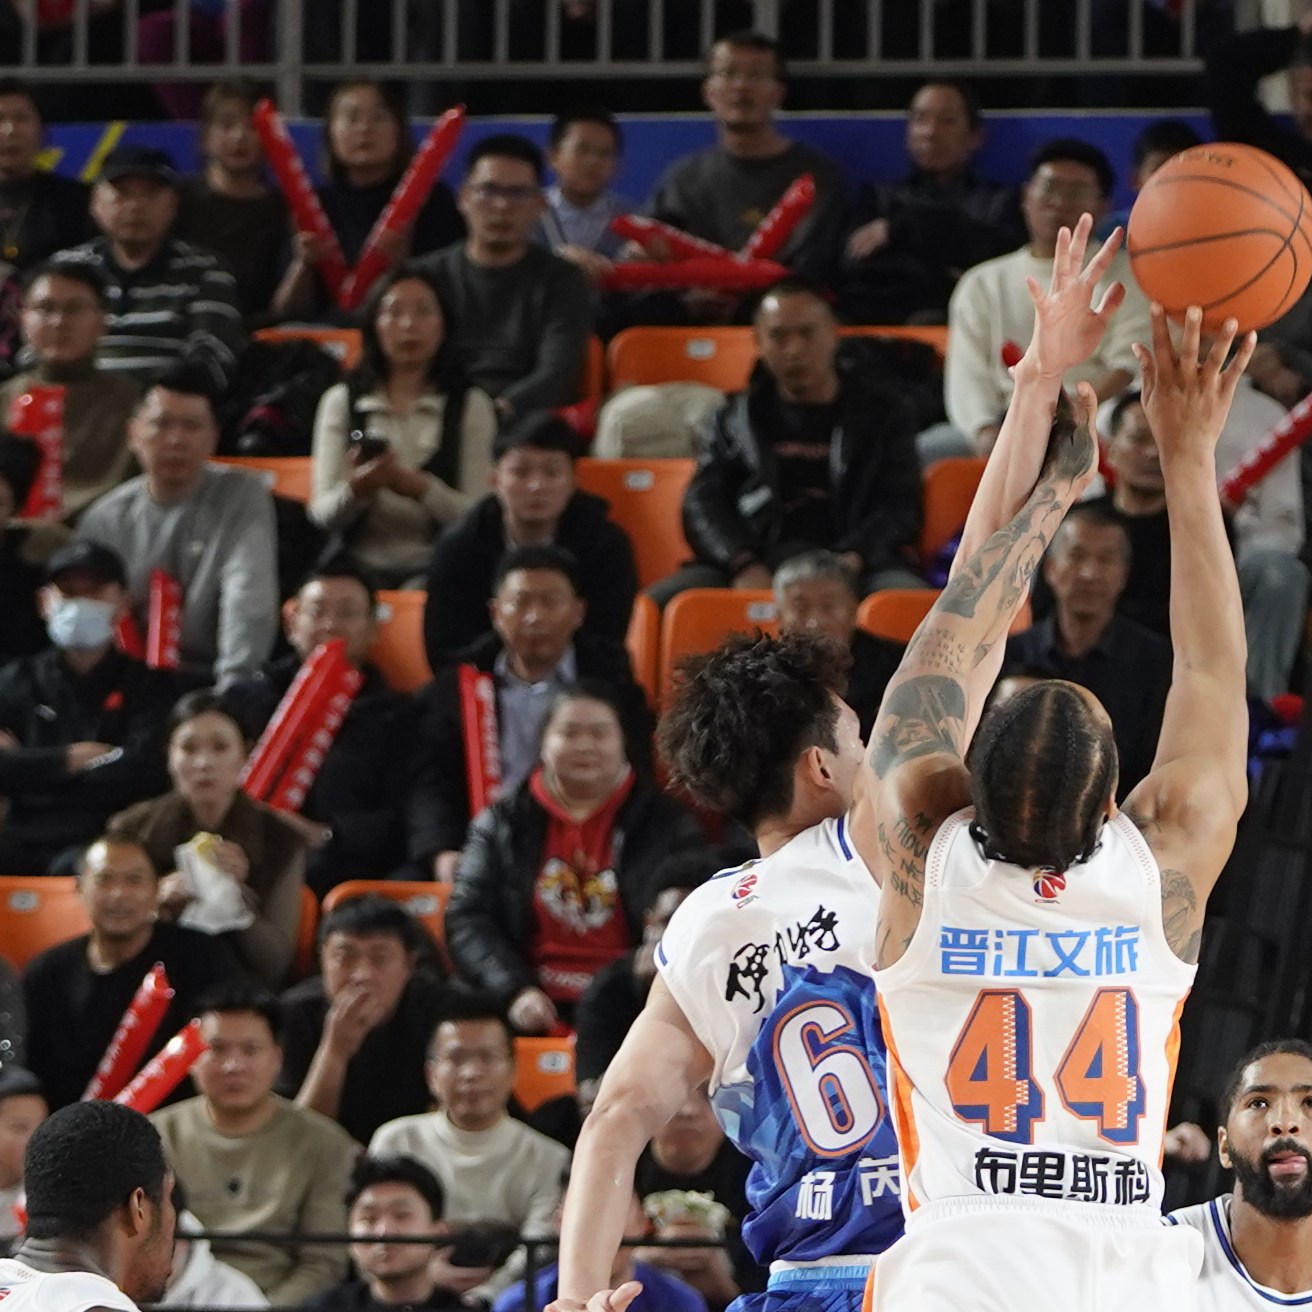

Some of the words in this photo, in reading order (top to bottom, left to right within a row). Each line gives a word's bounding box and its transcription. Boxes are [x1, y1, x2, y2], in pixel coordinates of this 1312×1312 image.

[939, 925, 1140, 977] 晋江文旅
[773, 1000, 886, 1157] 6
[944, 986, 1146, 1146] 44
[974, 1147, 1151, 1206] 布里斯科
